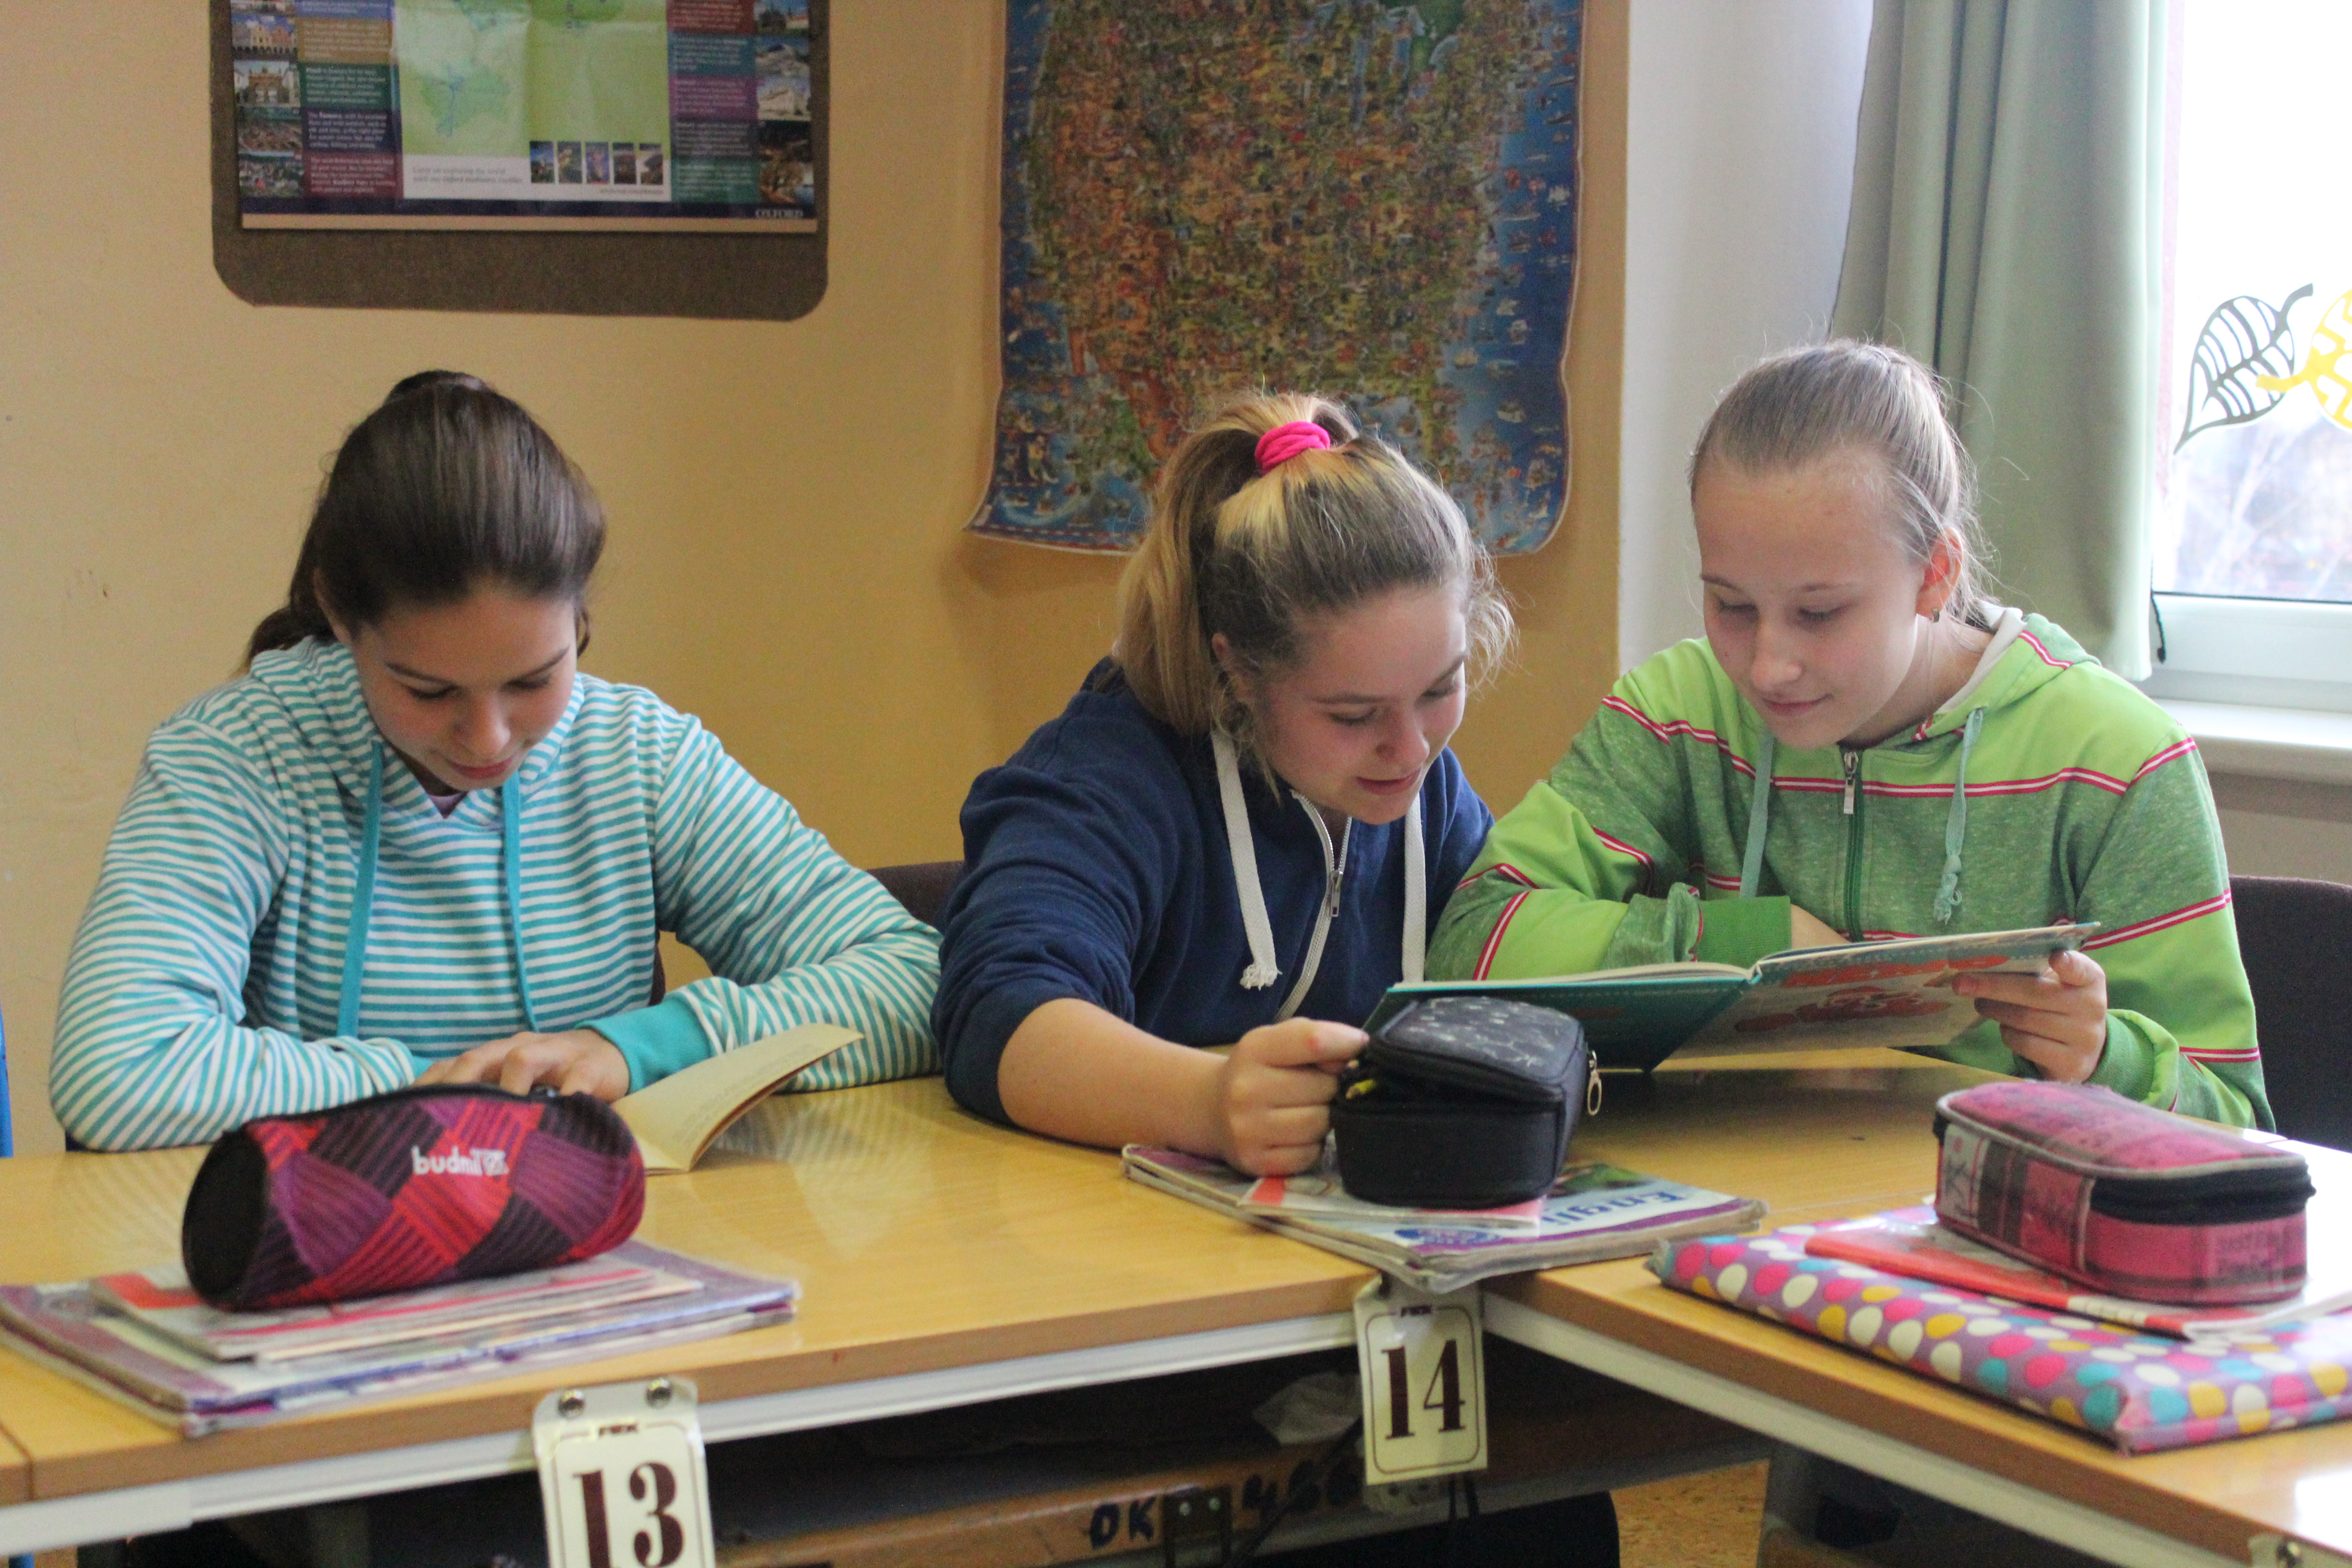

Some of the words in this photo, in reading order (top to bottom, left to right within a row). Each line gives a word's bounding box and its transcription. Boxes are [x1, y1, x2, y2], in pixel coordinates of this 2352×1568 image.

[1542, 1191, 1685, 1226] Engli
[1381, 1338, 1466, 1440] 14
[573, 1461, 686, 1568] 13
[1089, 1497, 1155, 1550] OK
